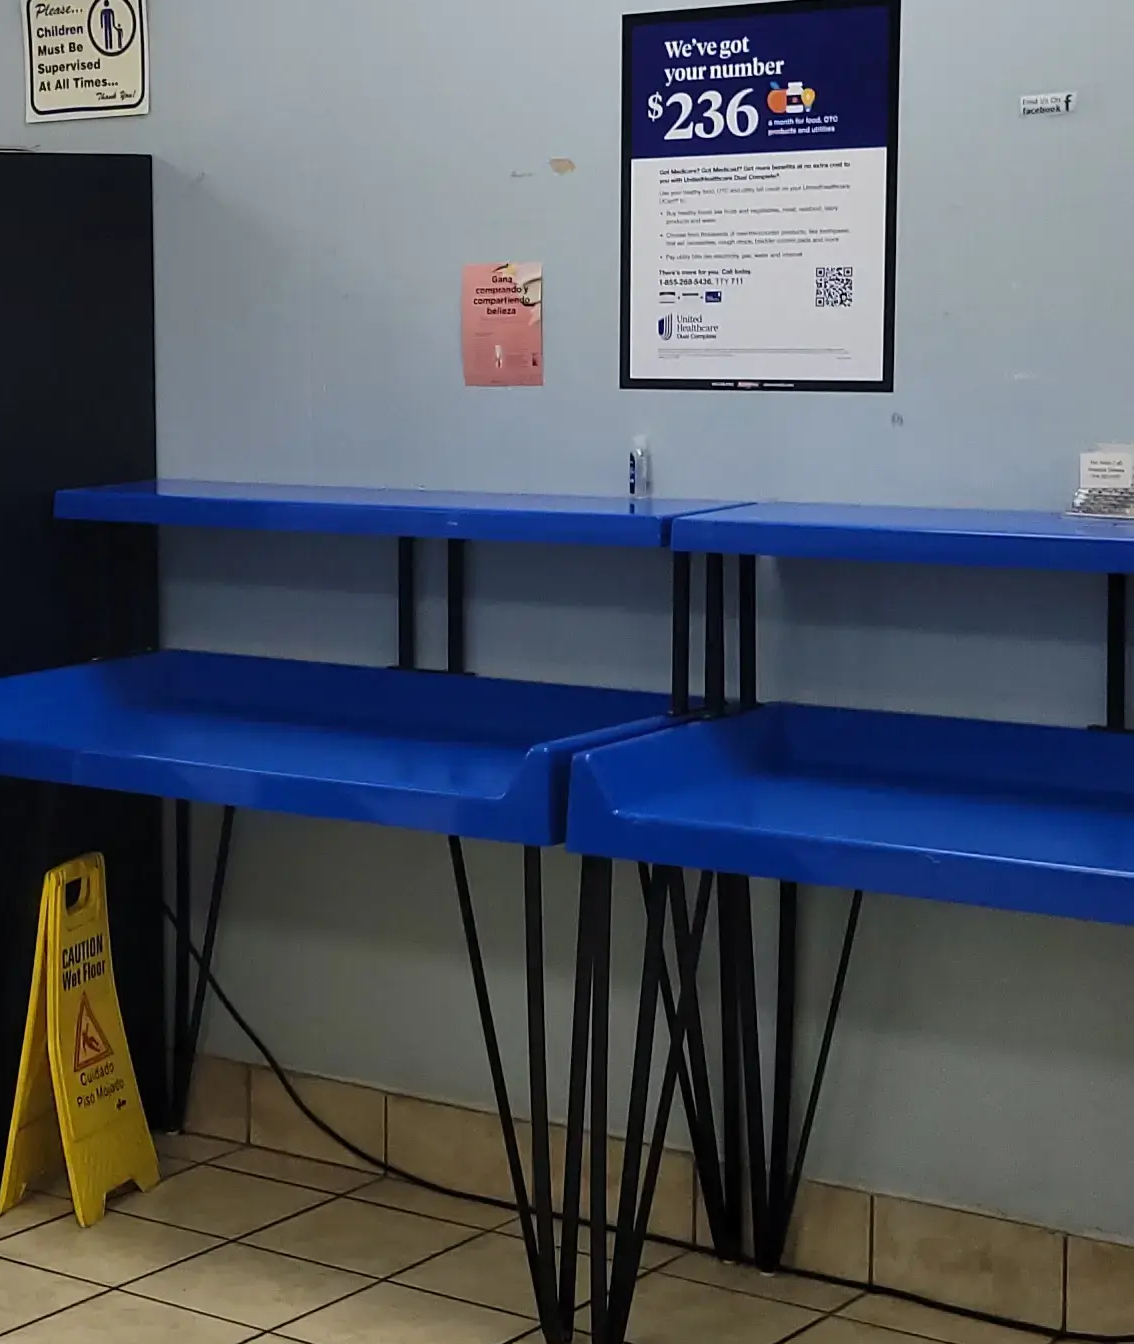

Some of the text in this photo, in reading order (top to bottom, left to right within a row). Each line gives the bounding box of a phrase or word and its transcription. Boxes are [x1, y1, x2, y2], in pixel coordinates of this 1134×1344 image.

[37, 25, 84, 39] Children
[38, 42, 83, 57] Must Be
[719, 36, 750, 59] got
[38, 58, 101, 75] Supervised
[664, 57, 785, 87] your number
[38, 81, 51, 92] At
[54, 78, 70, 90] All
[96, 91, 117, 101] Thank
[476, 286, 522, 294] comprando
[474, 296, 530, 305] compartiendo
[676, 314, 702, 324] United
[676, 324, 718, 332] Healthcare
[62, 933, 103, 969] CAUTION
[62, 959, 106, 992] Wet Floor
[80, 1062, 115, 1086] Cuidado
[77, 1093, 96, 1108] Piso
